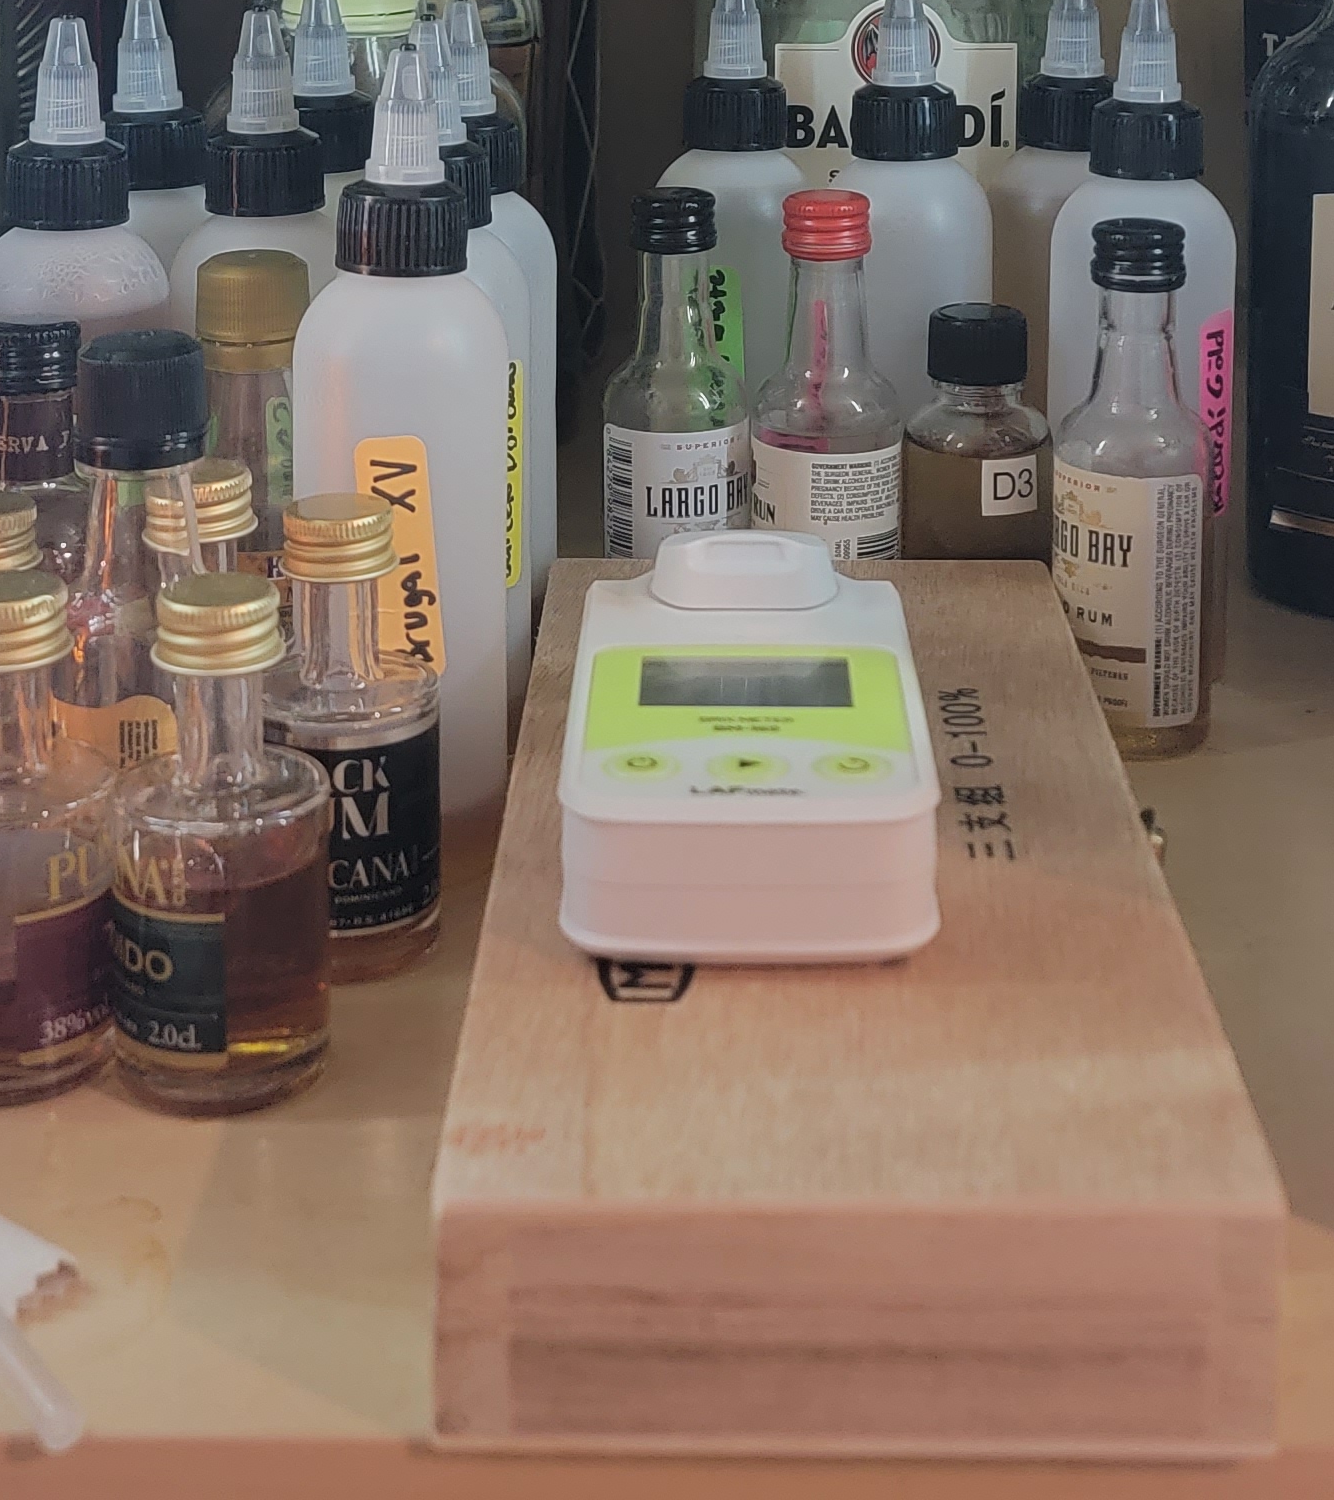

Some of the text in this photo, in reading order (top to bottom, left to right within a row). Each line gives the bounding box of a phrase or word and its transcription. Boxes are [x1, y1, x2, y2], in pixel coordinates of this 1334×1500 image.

[785, 88, 1007, 150] BADÍ
[370, 459, 418, 513] XV
[644, 472, 749, 520] LARGO BAY
[993, 468, 1035, 502] D3
[1087, 528, 1134, 568] BAY
[1076, 605, 1113, 627] RUM
[937, 688, 994, 768] 0-100%
